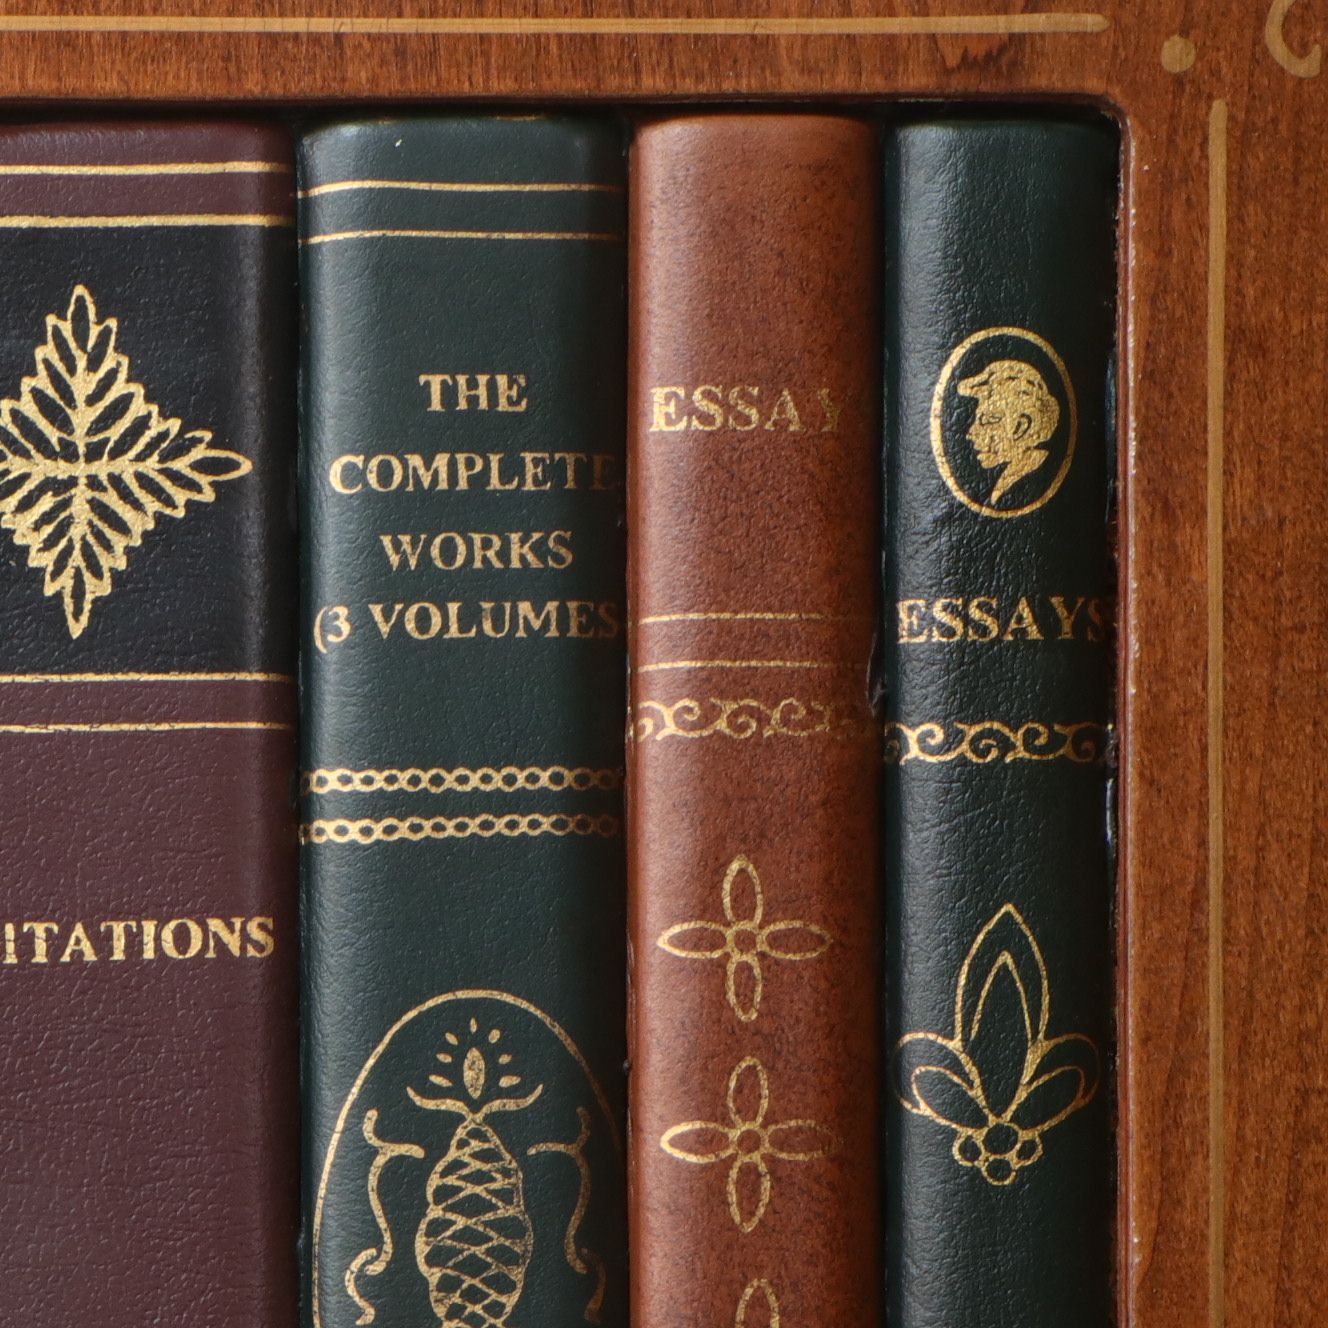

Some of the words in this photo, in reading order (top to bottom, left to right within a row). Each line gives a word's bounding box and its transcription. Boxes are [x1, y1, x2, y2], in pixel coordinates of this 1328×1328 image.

[419, 373, 528, 412] THE
[379, 530, 573, 571] WORKS
[313, 605, 351, 654] (3
[368, 600, 618, 639] VOLUMES
[896, 596, 1107, 644] ESSAYS
